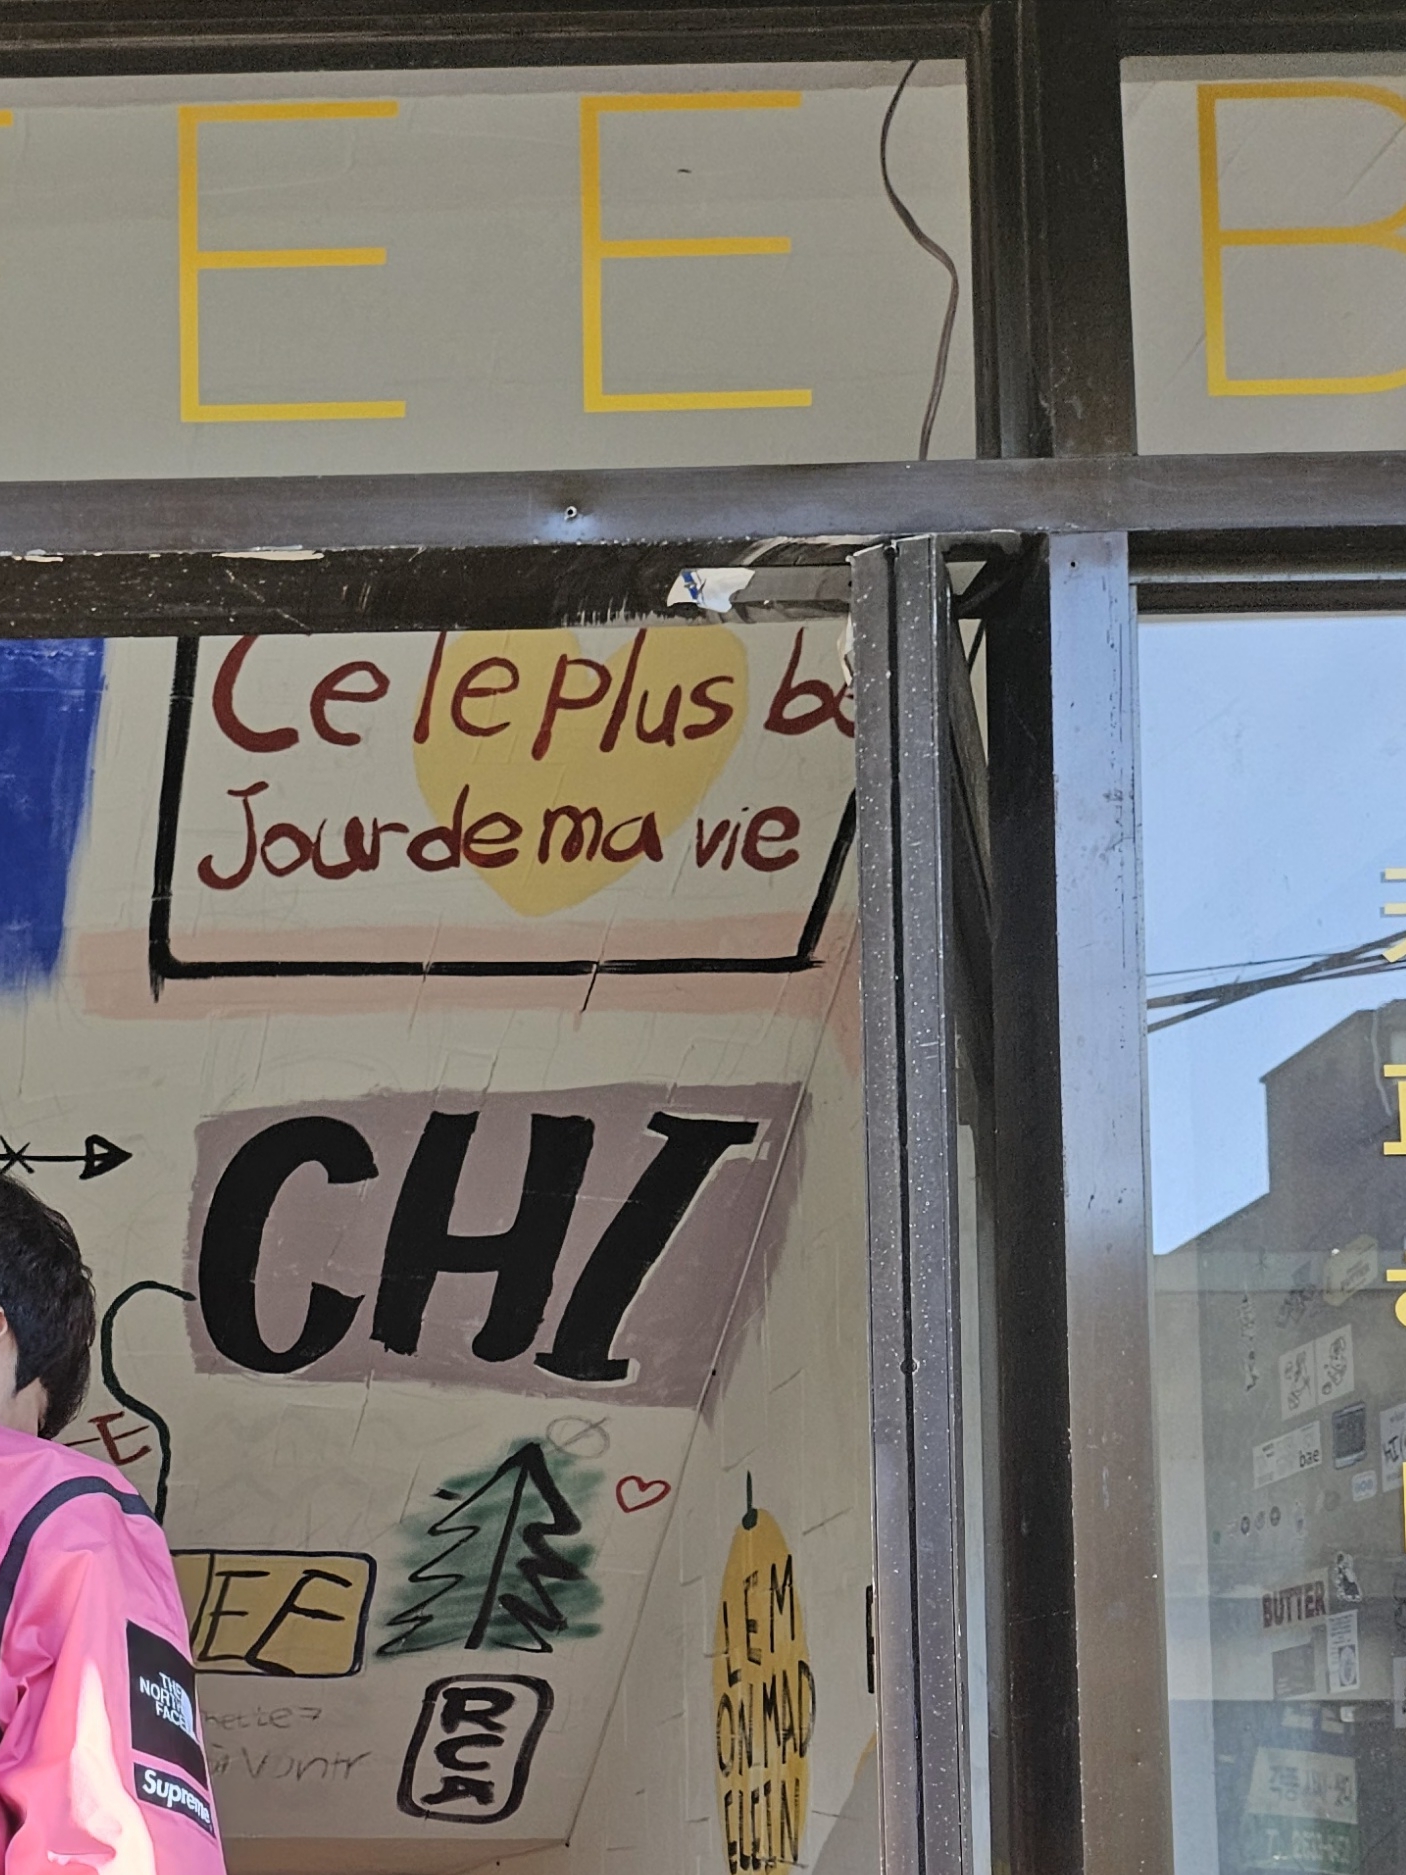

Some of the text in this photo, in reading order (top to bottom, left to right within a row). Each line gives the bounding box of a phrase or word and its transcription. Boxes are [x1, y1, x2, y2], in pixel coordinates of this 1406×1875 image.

[198, 1110, 761, 1383] CHI
[1262, 1579, 1327, 1630] BUTTER
[139, 1675, 185, 1713] NORTH
[158, 1671, 183, 1699] THE
[155, 1701, 190, 1732] FACE
[142, 1769, 211, 1824] Supreme
